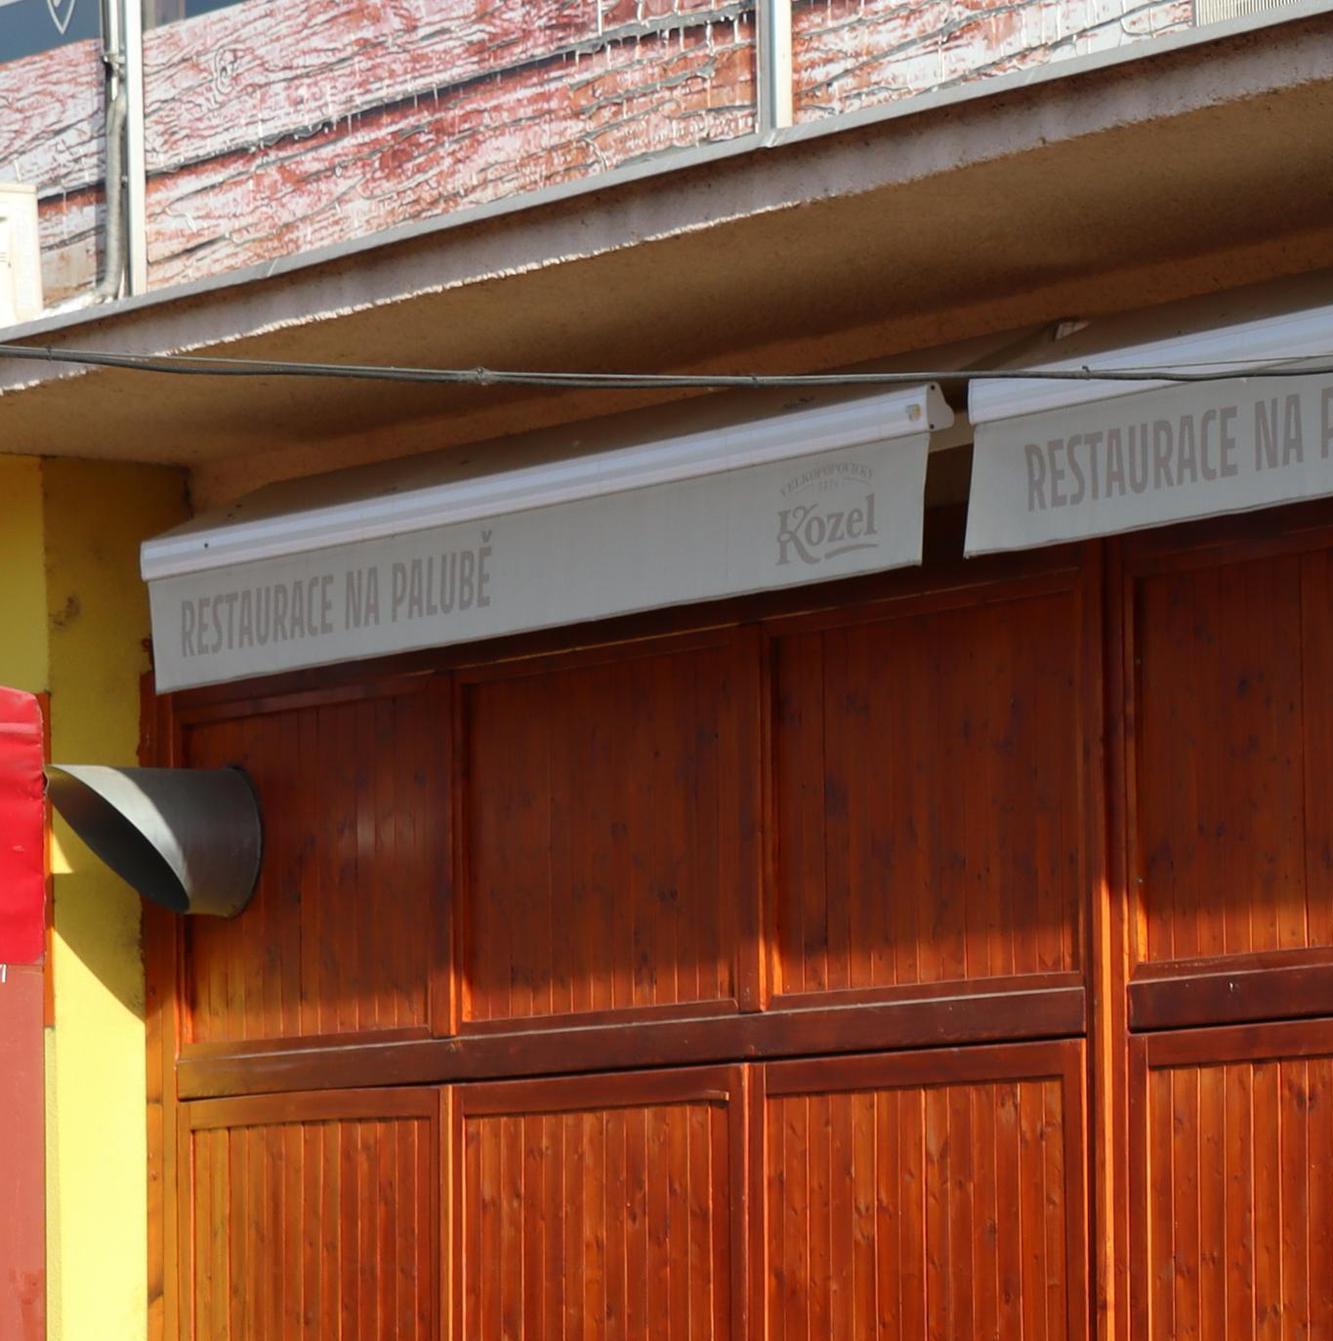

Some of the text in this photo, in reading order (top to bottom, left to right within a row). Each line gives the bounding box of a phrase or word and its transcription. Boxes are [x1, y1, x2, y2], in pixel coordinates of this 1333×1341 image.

[1024, 405, 1239, 512] RESTAURACE
[1254, 393, 1304, 472] NA
[776, 493, 879, 565] Kozel
[180, 529, 493, 658] RESTAURACE NA PALUBĚ
